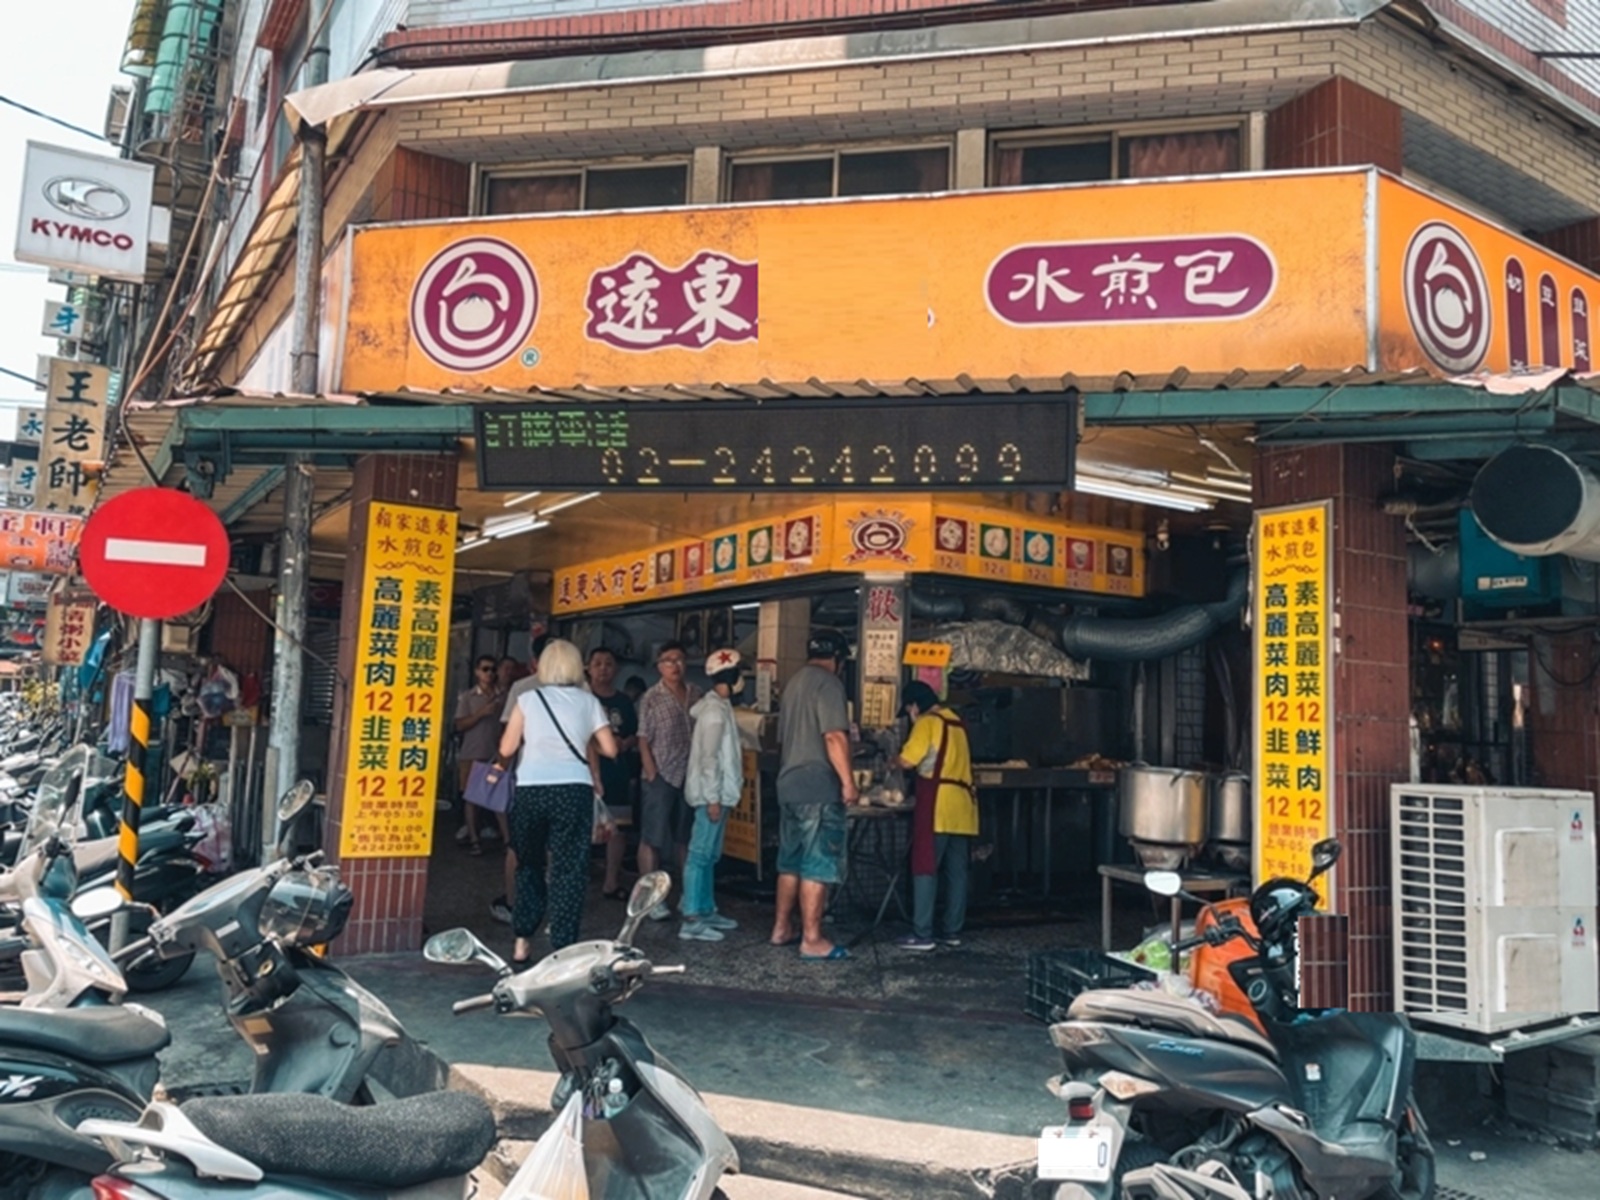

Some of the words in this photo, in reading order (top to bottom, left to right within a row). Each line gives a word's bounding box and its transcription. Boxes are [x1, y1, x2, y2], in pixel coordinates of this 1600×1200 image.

[31, 218, 134, 251] KYMCO
[1008, 250, 1250, 313] 水煎包
[596, 256, 752, 344] 遠東
[49, 305, 80, 335] 牙
[51, 370, 98, 497] 王老師
[602, 443, 1022, 483] 02-24242099
[377, 536, 446, 560] 水煎包
[1265, 540, 1318, 562] 水煎包
[364, 576, 404, 687] 高麗菜肉
[405, 579, 442, 688] 素高麗菜
[1265, 583, 1289, 698] 高麗菜肉
[1294, 580, 1321, 698] 素高麗菜
[364, 691, 394, 712] 12
[405, 692, 433, 714] 12
[1265, 701, 1289, 722] 12
[1295, 701, 1321, 723] 12
[358, 715, 391, 771] 韭菜
[398, 716, 432, 772] 鮮肉
[1265, 727, 1291, 789] 韭菜
[1295, 728, 1322, 793] 鮮肉
[356, 775, 387, 797] 12
[397, 775, 426, 797] 12
[1265, 795, 1290, 817] 12
[1296, 797, 1322, 821] 12
